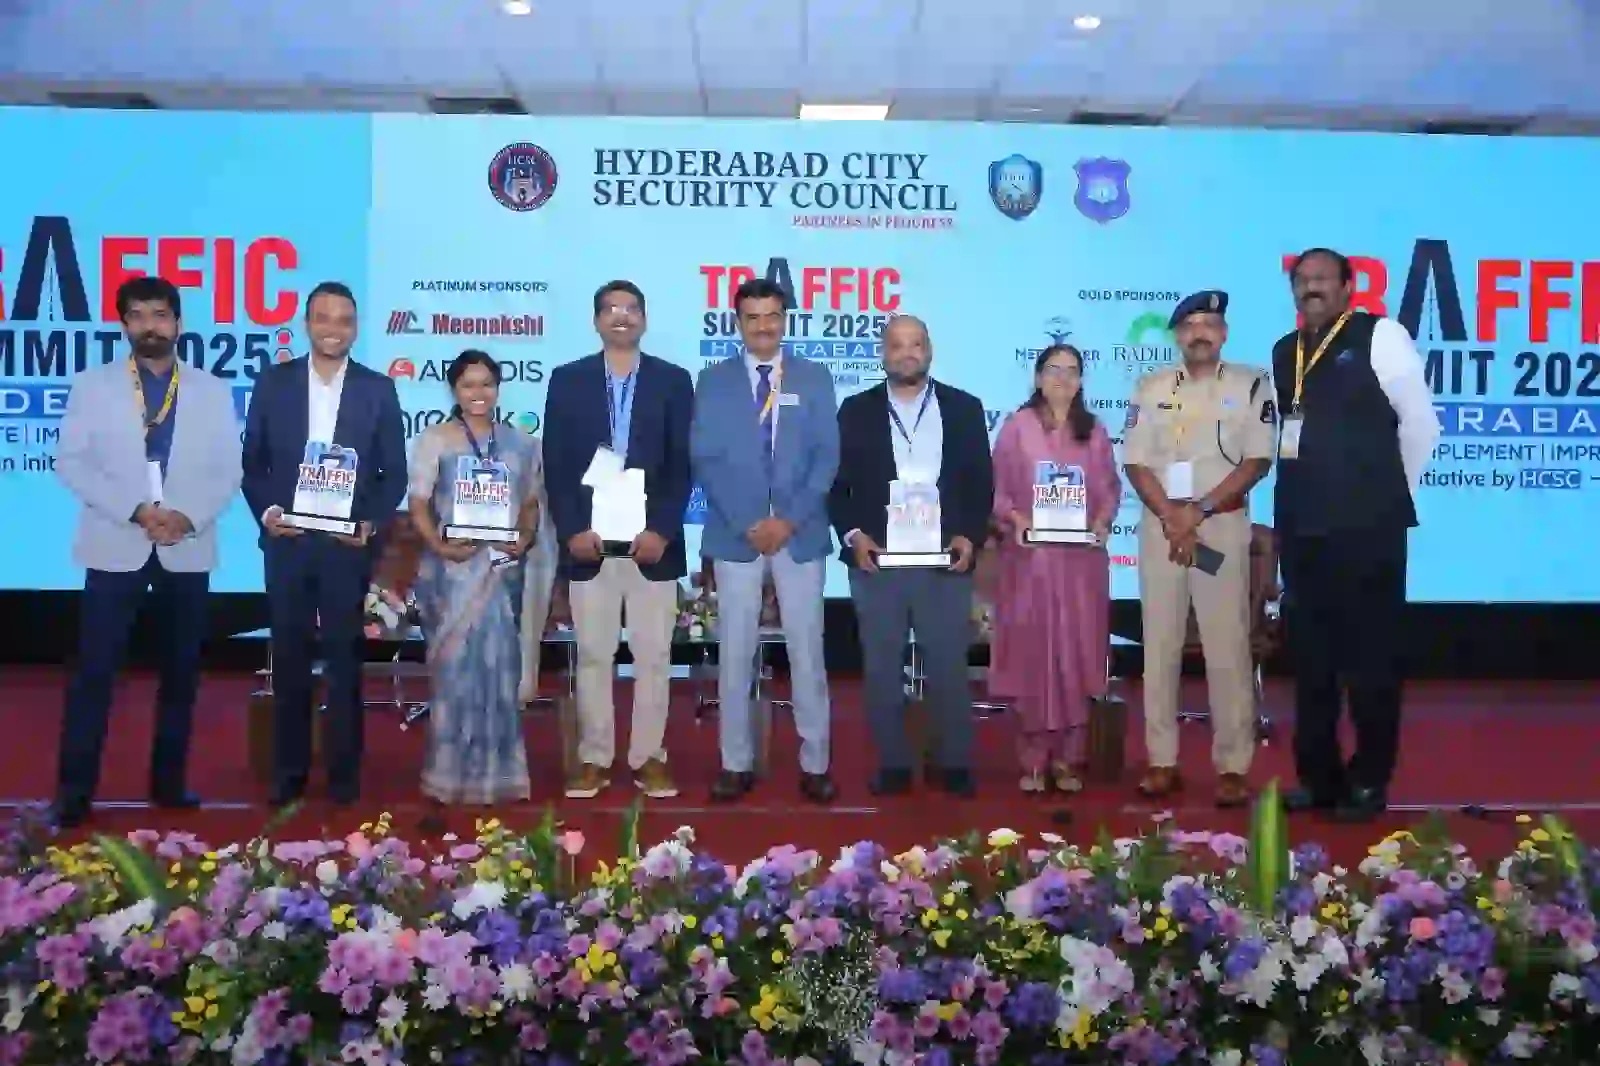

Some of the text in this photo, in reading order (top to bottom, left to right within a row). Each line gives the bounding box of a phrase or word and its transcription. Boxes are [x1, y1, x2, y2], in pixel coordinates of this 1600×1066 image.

[594, 149, 928, 181] HYDERABAD CITY
[594, 180, 957, 211] SECURITY COUNCIL
[0, 215, 300, 327] AFFIC
[412, 280, 548, 292] PLATINUM SPONSORS
[1078, 289, 1181, 302] GOLD SPONSORS
[431, 312, 544, 336] Meenakshi
[1513, 350, 1600, 398] 202
[1492, 469, 1516, 491] by
[1522, 470, 1581, 488] HCSC
